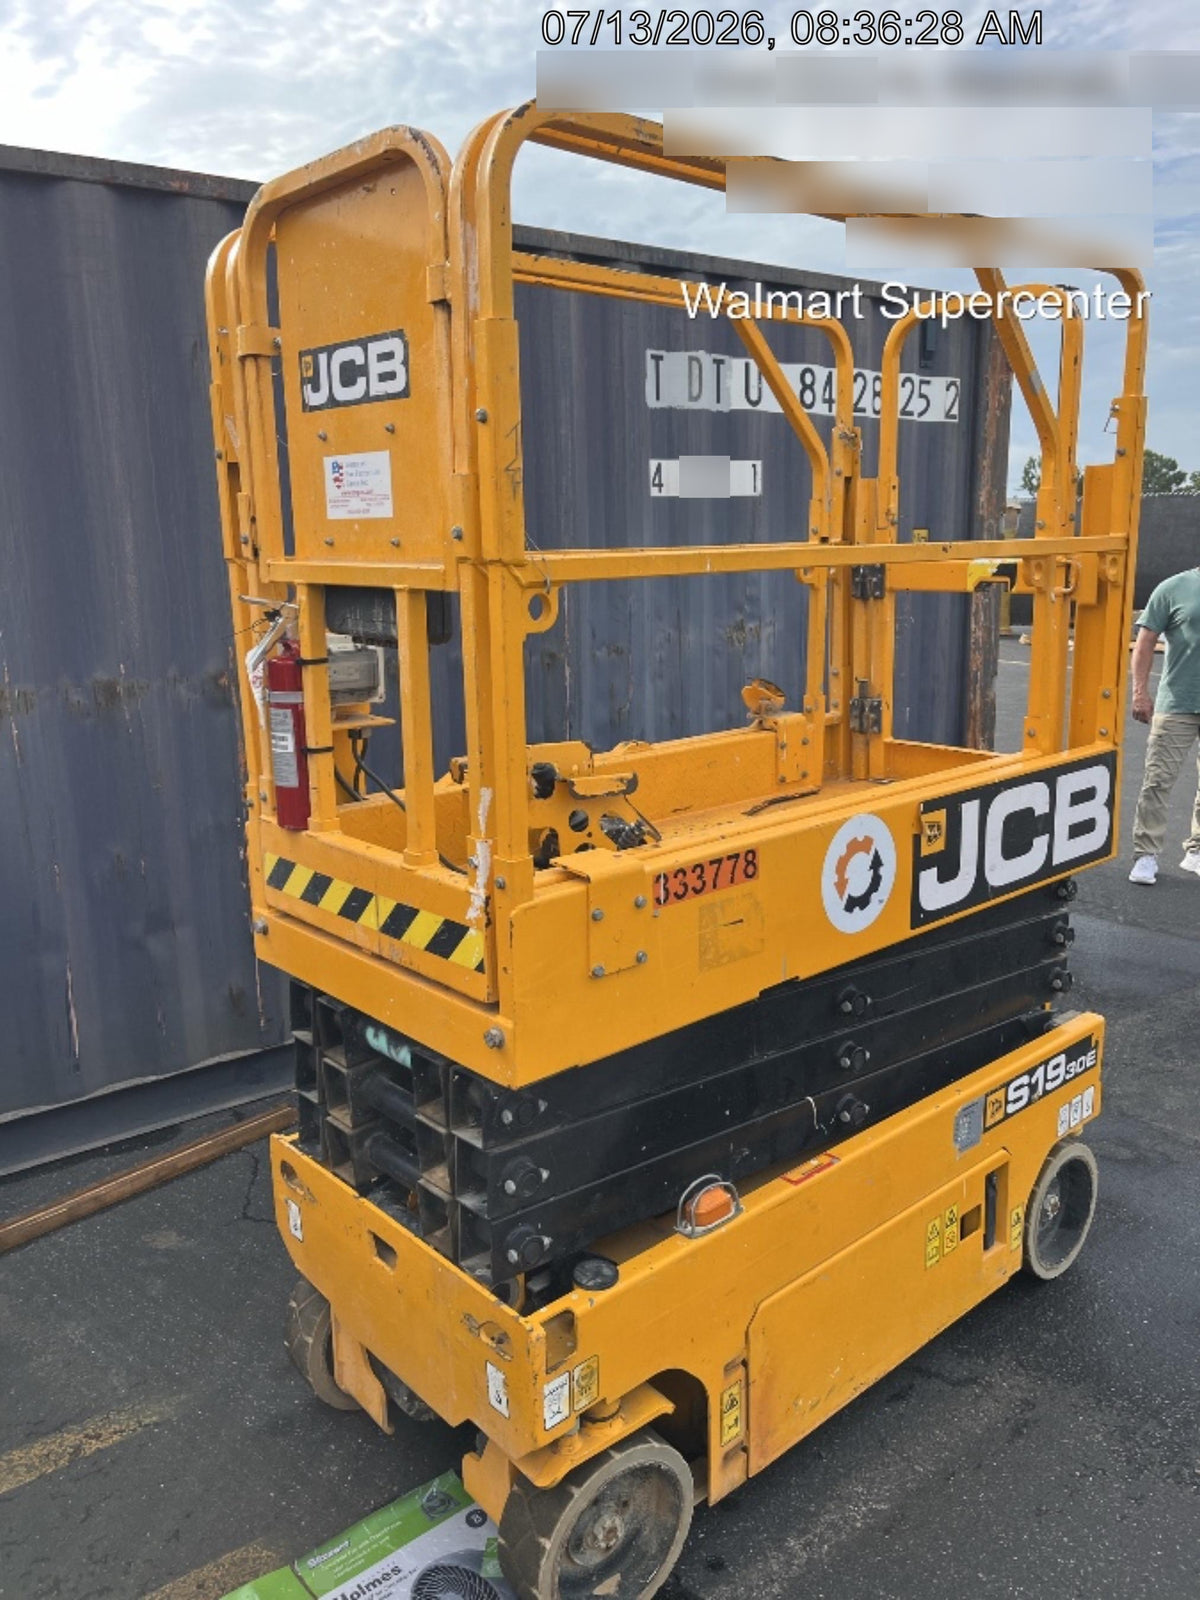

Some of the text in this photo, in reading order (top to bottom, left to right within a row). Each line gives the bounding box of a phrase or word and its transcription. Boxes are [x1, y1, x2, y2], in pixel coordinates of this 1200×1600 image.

[303, 337, 407, 406] JCB
[919, 764, 1111, 911] JCB
[654, 849, 757, 905] 333778
